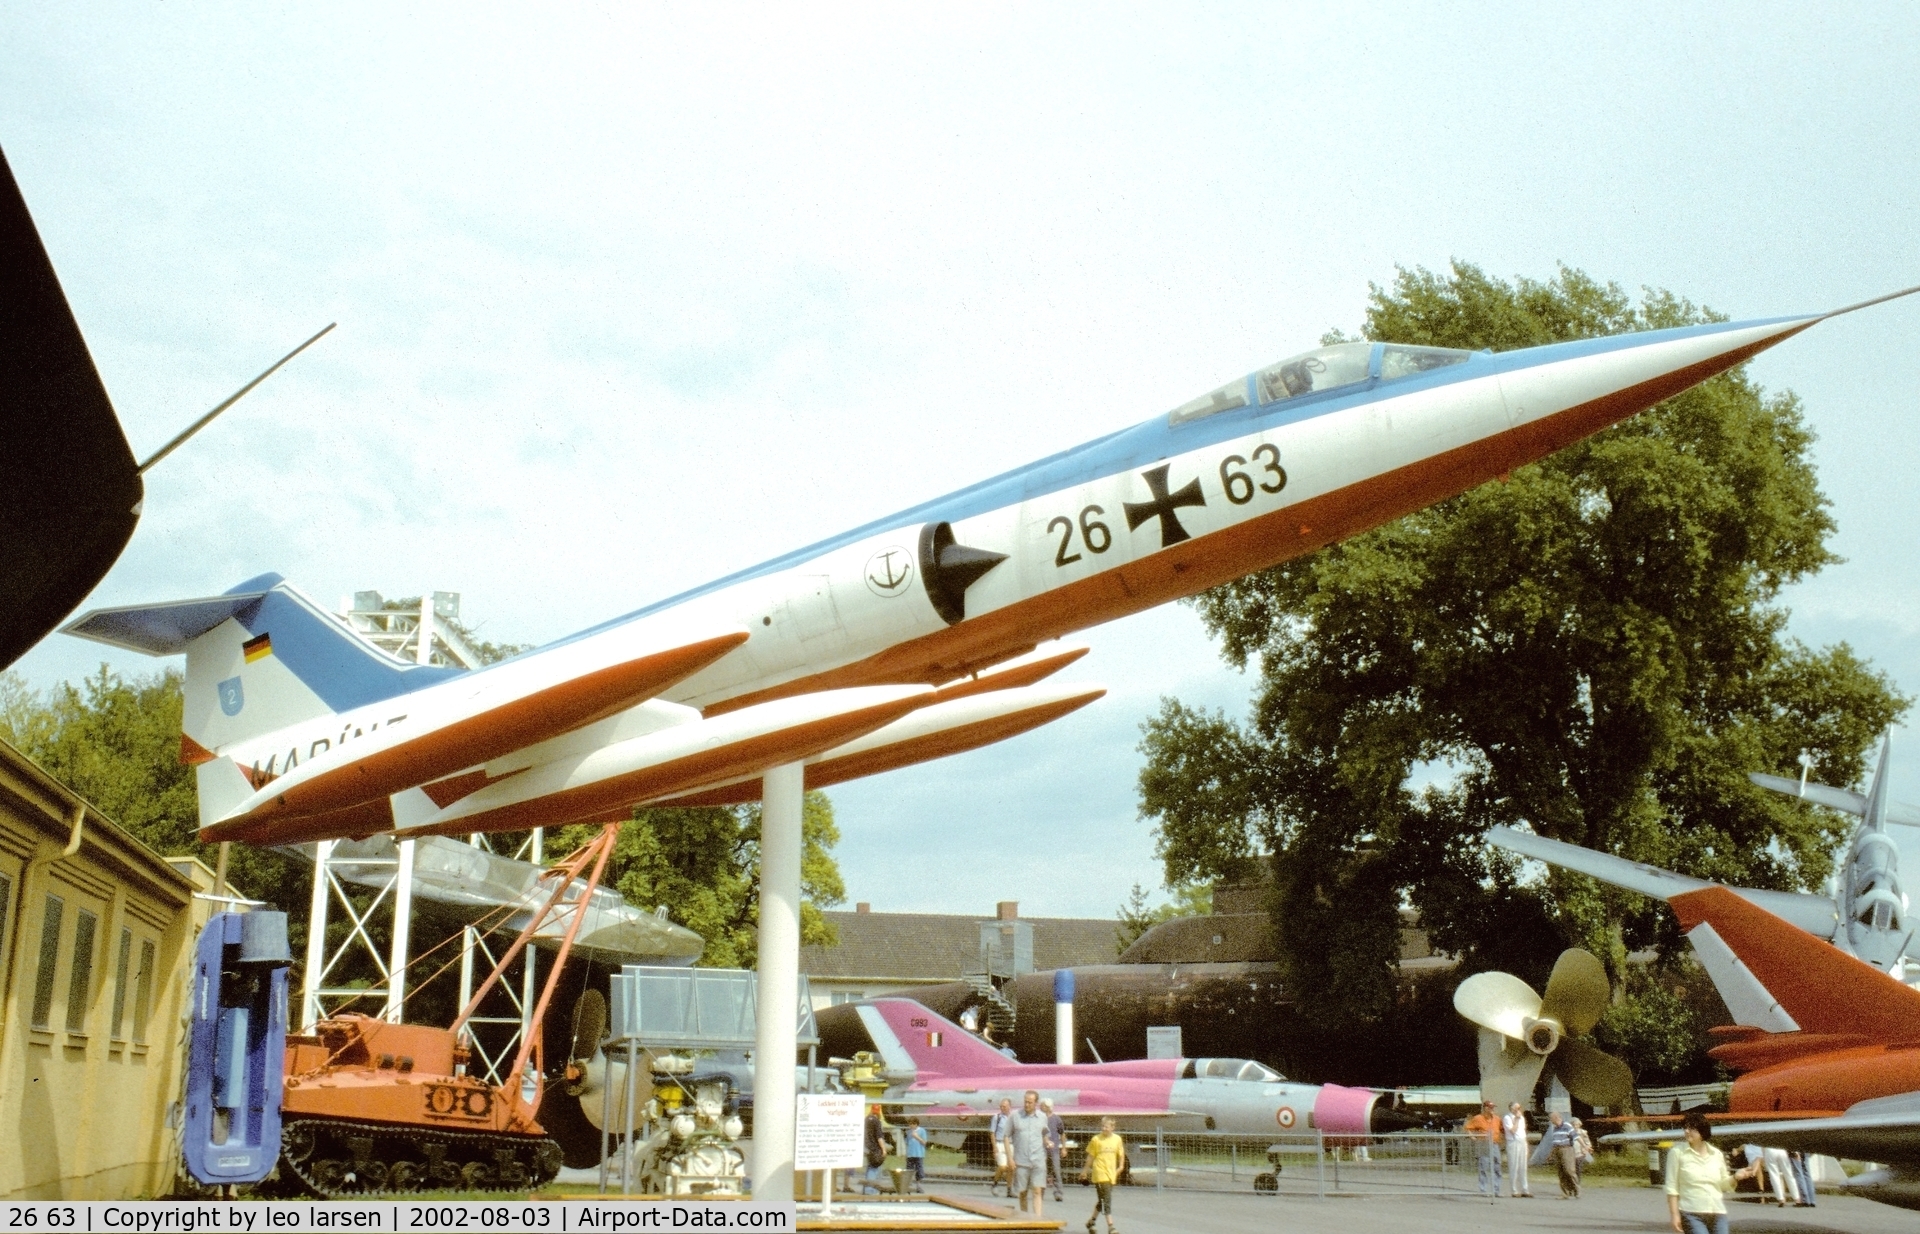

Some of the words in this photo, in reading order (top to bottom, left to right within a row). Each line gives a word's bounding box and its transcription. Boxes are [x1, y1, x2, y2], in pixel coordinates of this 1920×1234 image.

[1047, 505, 1112, 568] 26
[1219, 443, 1288, 505] 63
[227, 689, 237, 705] 2
